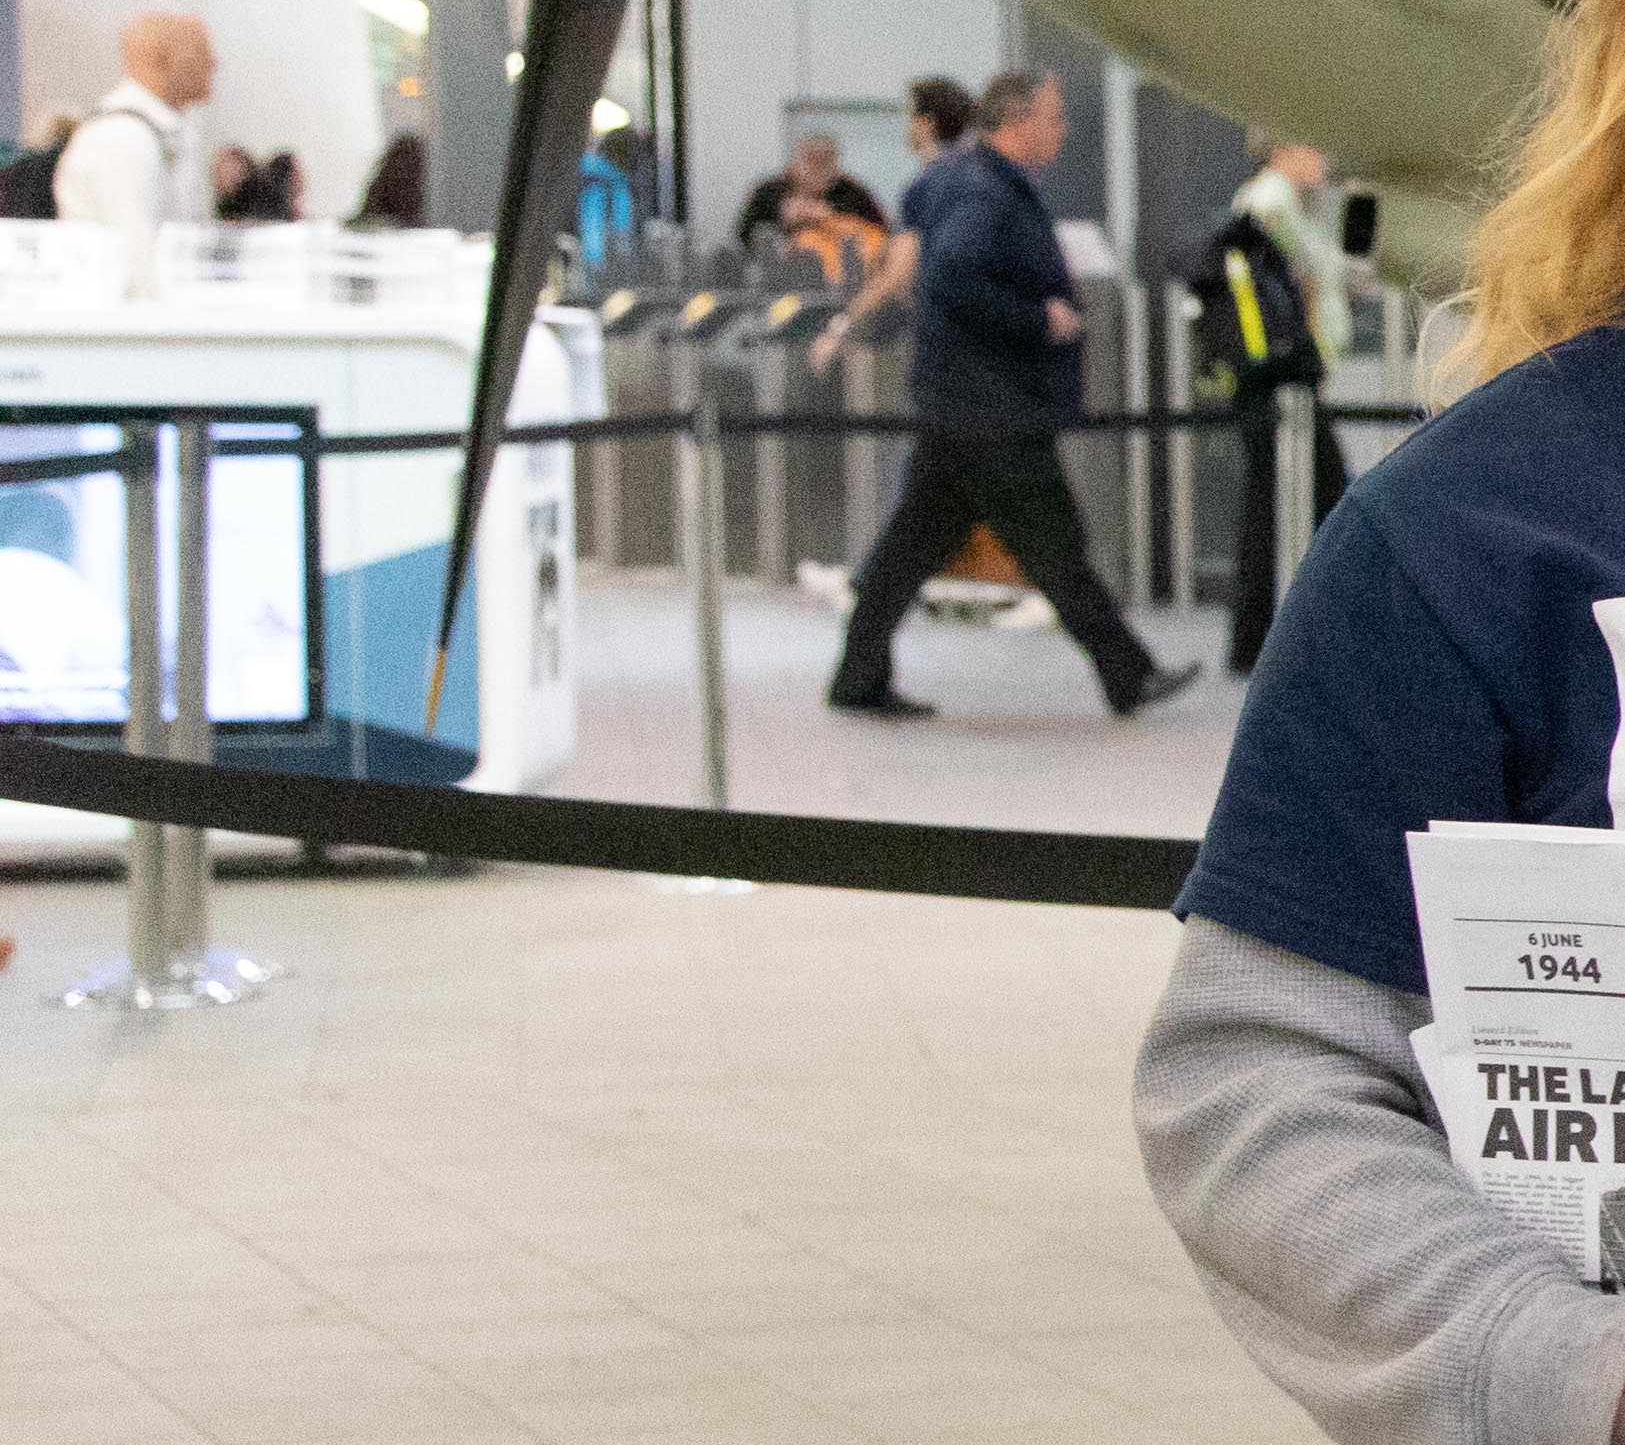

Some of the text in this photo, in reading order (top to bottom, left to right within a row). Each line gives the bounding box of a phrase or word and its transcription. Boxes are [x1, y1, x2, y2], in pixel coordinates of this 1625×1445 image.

[1527, 932, 1584, 950] 6 JUNE
[1517, 952, 1602, 984] 1944
[1478, 1063, 1571, 1103] THE
[1481, 1107, 1599, 1163] AIR
